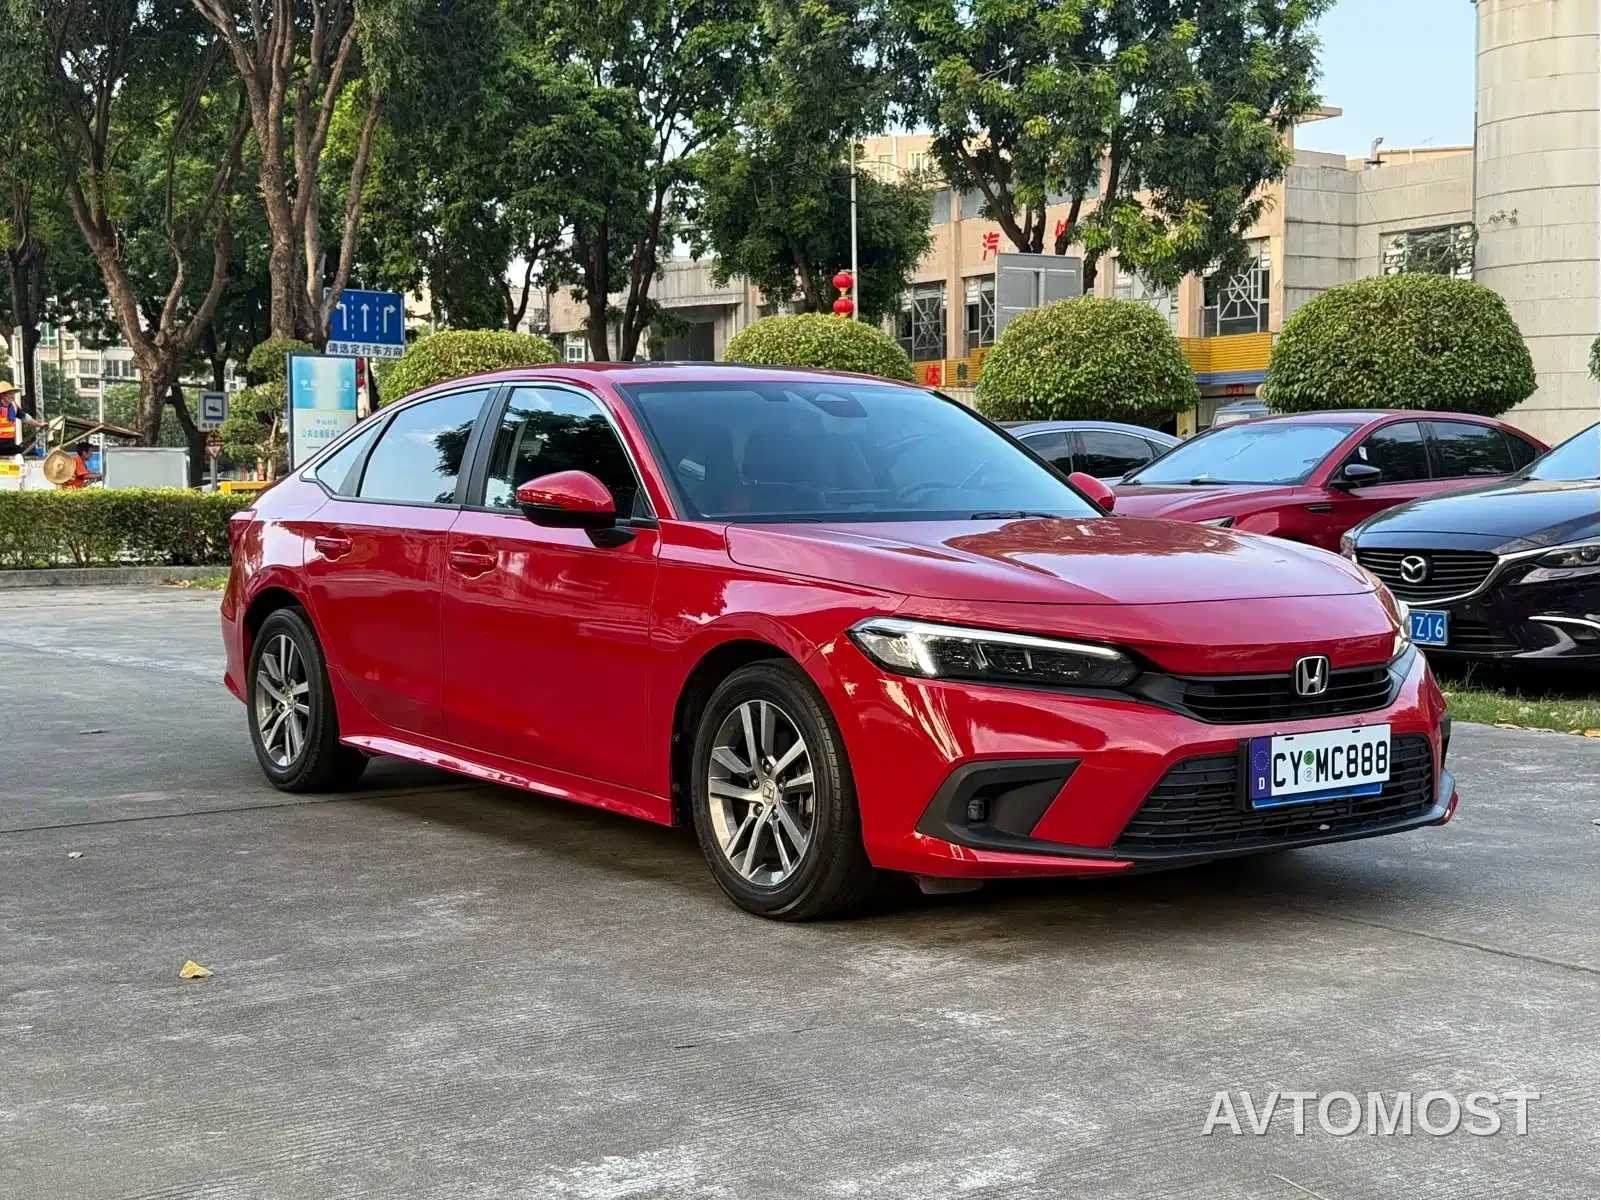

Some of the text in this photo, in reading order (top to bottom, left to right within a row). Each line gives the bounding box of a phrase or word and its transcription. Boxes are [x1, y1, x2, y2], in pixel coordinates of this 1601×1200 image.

[328, 342, 403, 357] 请选定行车方向
[1409, 616, 1444, 639] Z16
[1273, 740, 1388, 788] CY MC888
[1258, 777, 1265, 790] D
